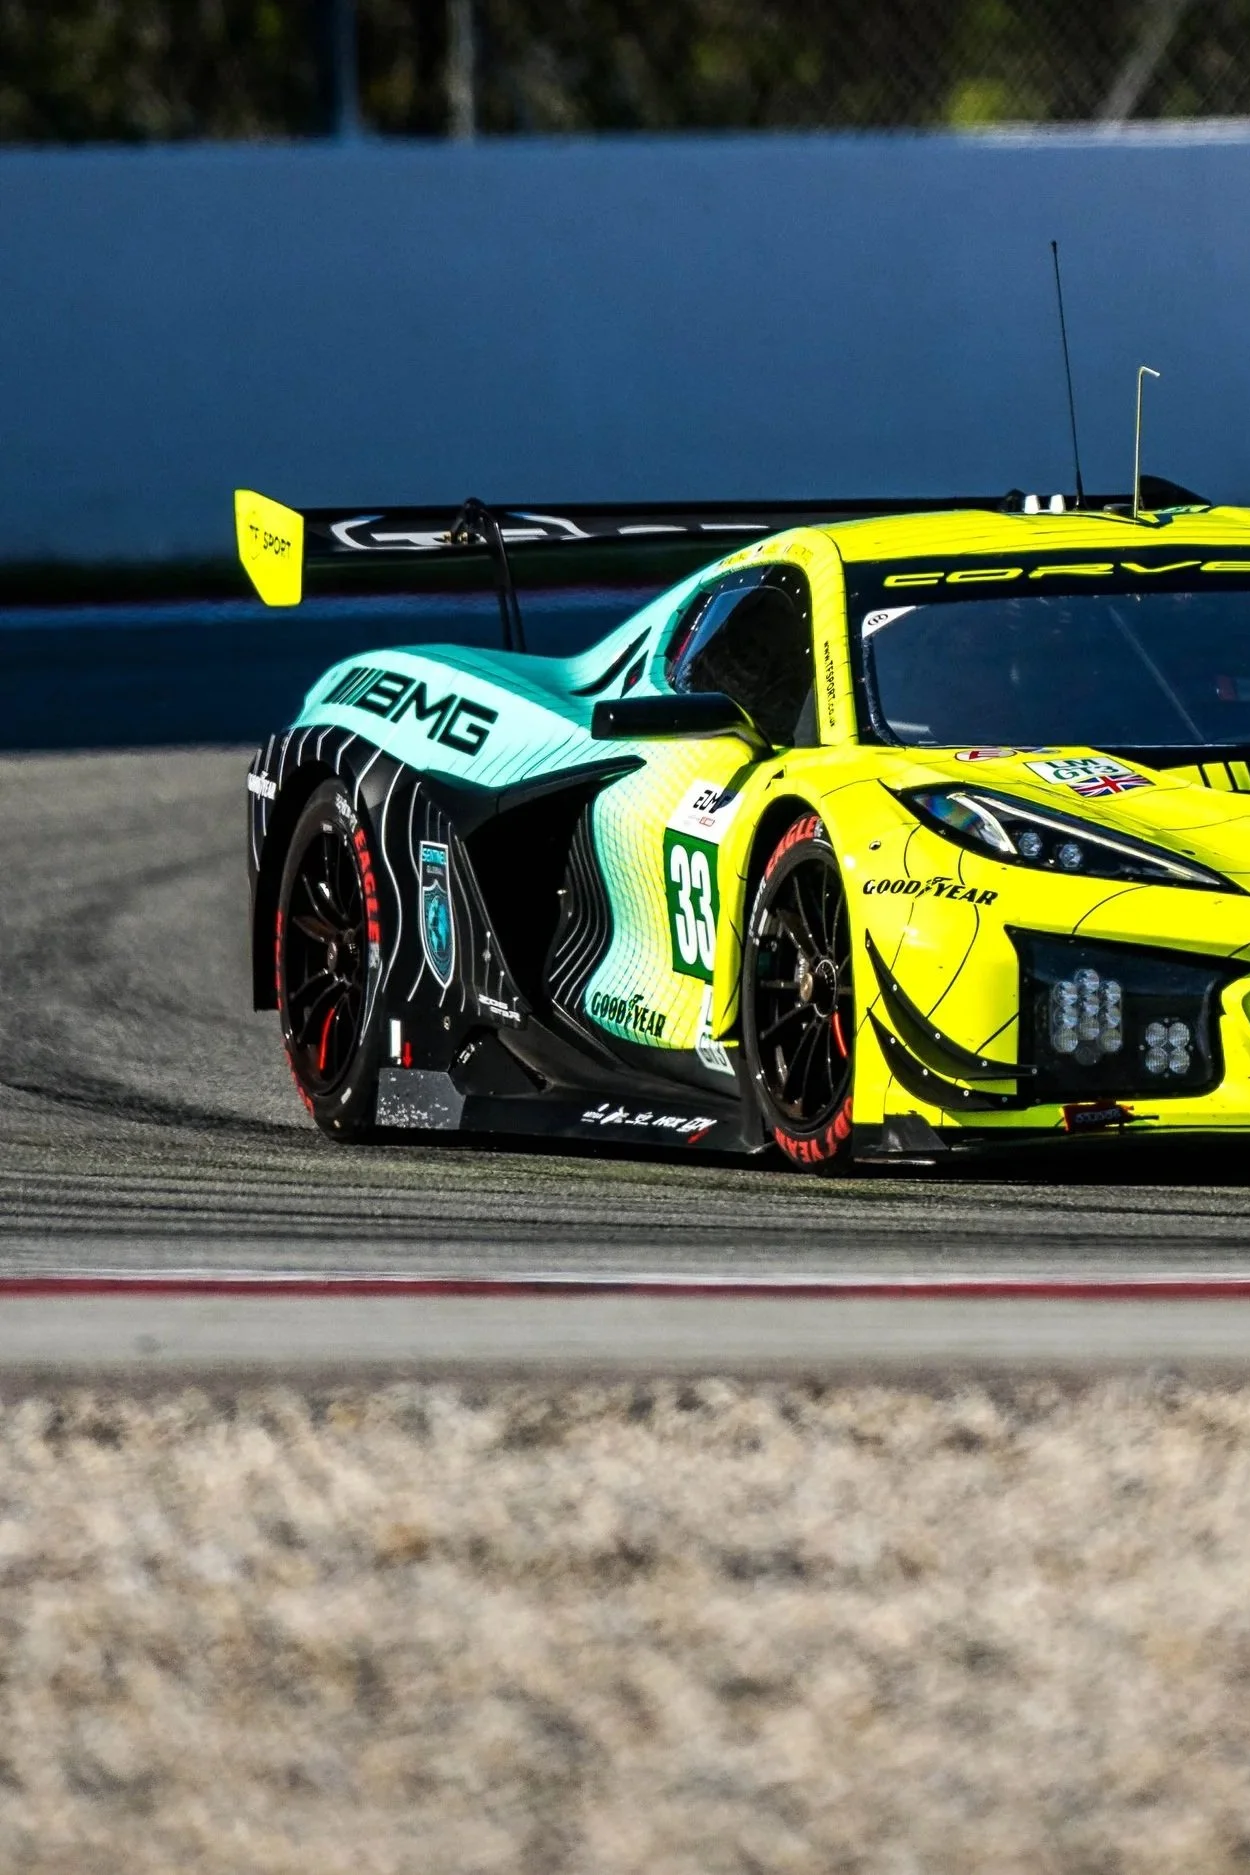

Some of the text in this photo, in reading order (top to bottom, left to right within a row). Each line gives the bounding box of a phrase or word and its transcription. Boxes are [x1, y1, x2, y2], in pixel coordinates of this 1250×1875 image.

[263, 532, 292, 561] SPORT
[1045, 758, 1101, 769] LM
[1053, 765, 1120, 781] GT3
[862, 876, 999, 906] GOODYEAR
[670, 844, 717, 971] 33
[590, 991, 667, 1039] GOODYEAR
